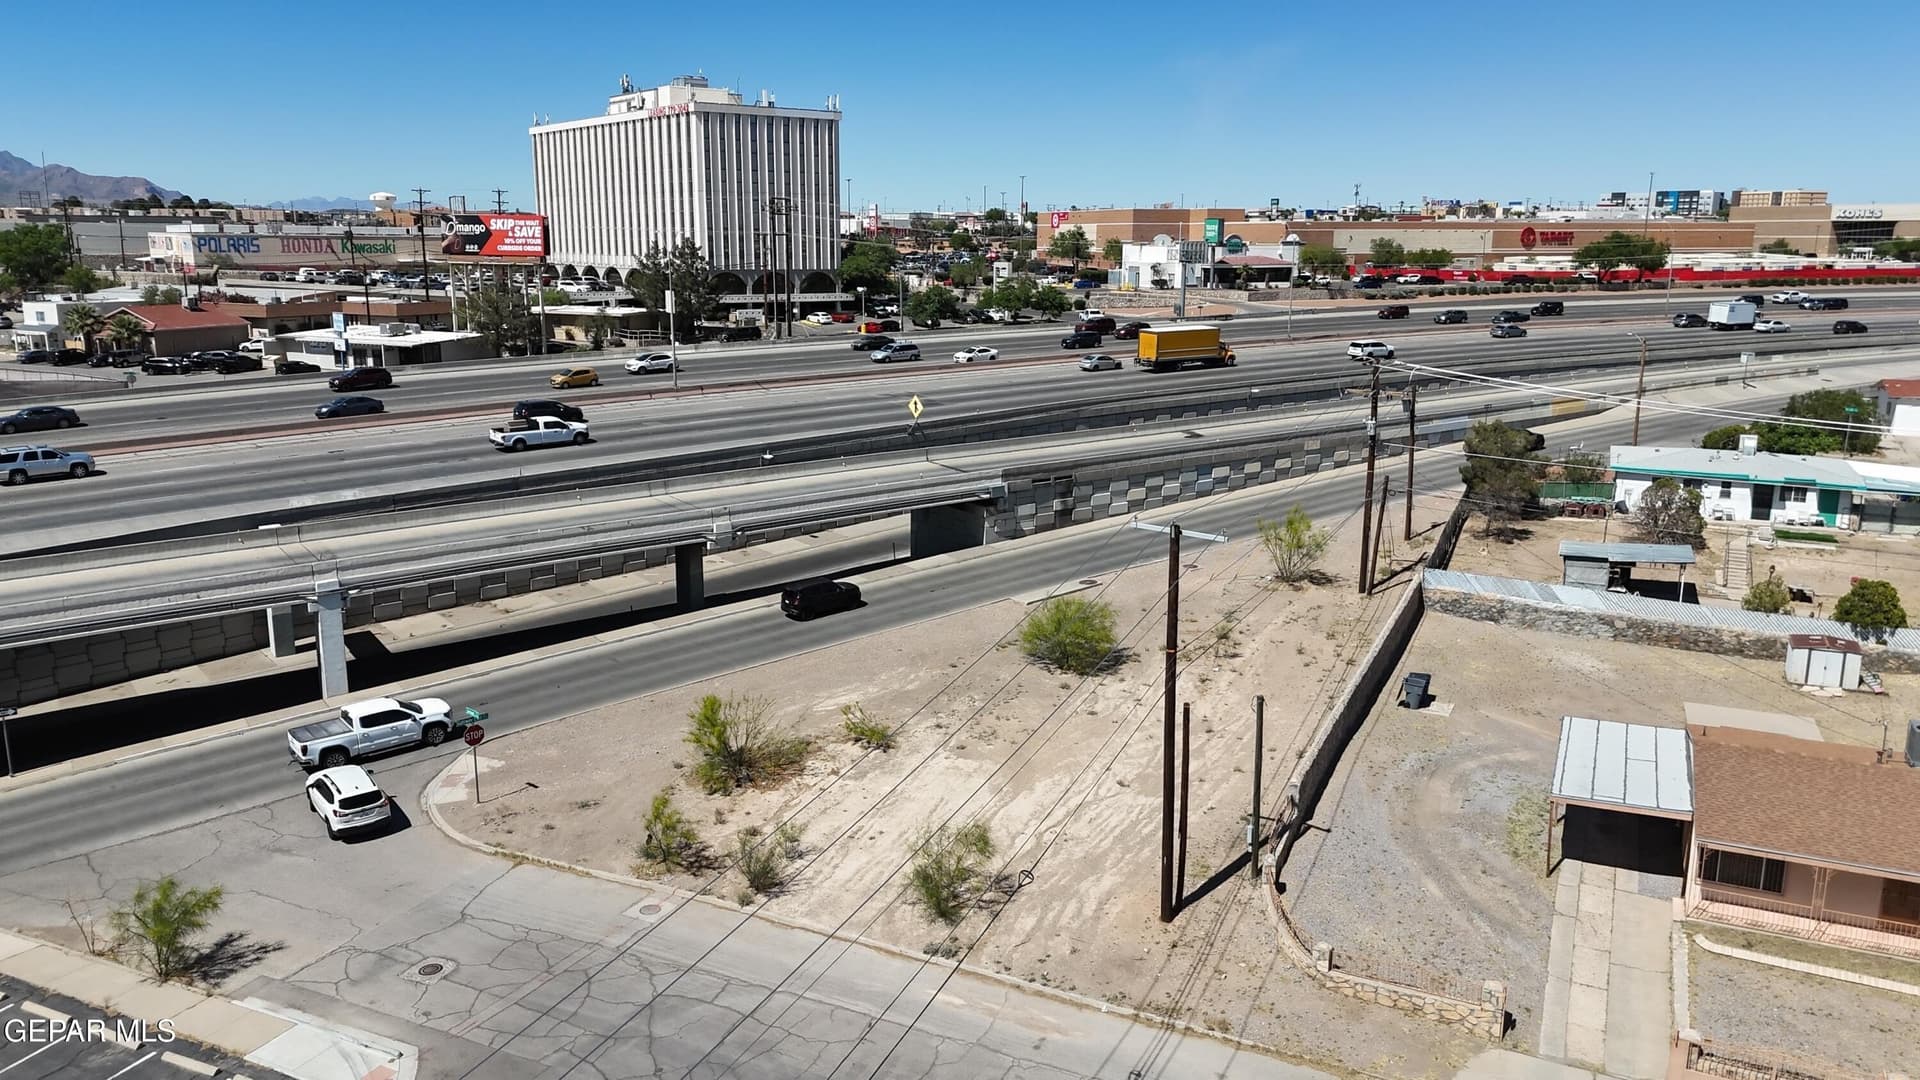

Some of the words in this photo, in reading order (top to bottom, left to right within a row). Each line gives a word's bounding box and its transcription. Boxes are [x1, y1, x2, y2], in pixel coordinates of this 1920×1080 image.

[490, 218, 514, 231] SKIP
[514, 226, 542, 238] SAVE
[197, 236, 262, 254] POLARIS
[280, 237, 335, 254] HONDA
[340, 238, 397, 256] Kawasaki
[465, 729, 484, 742] STOP
